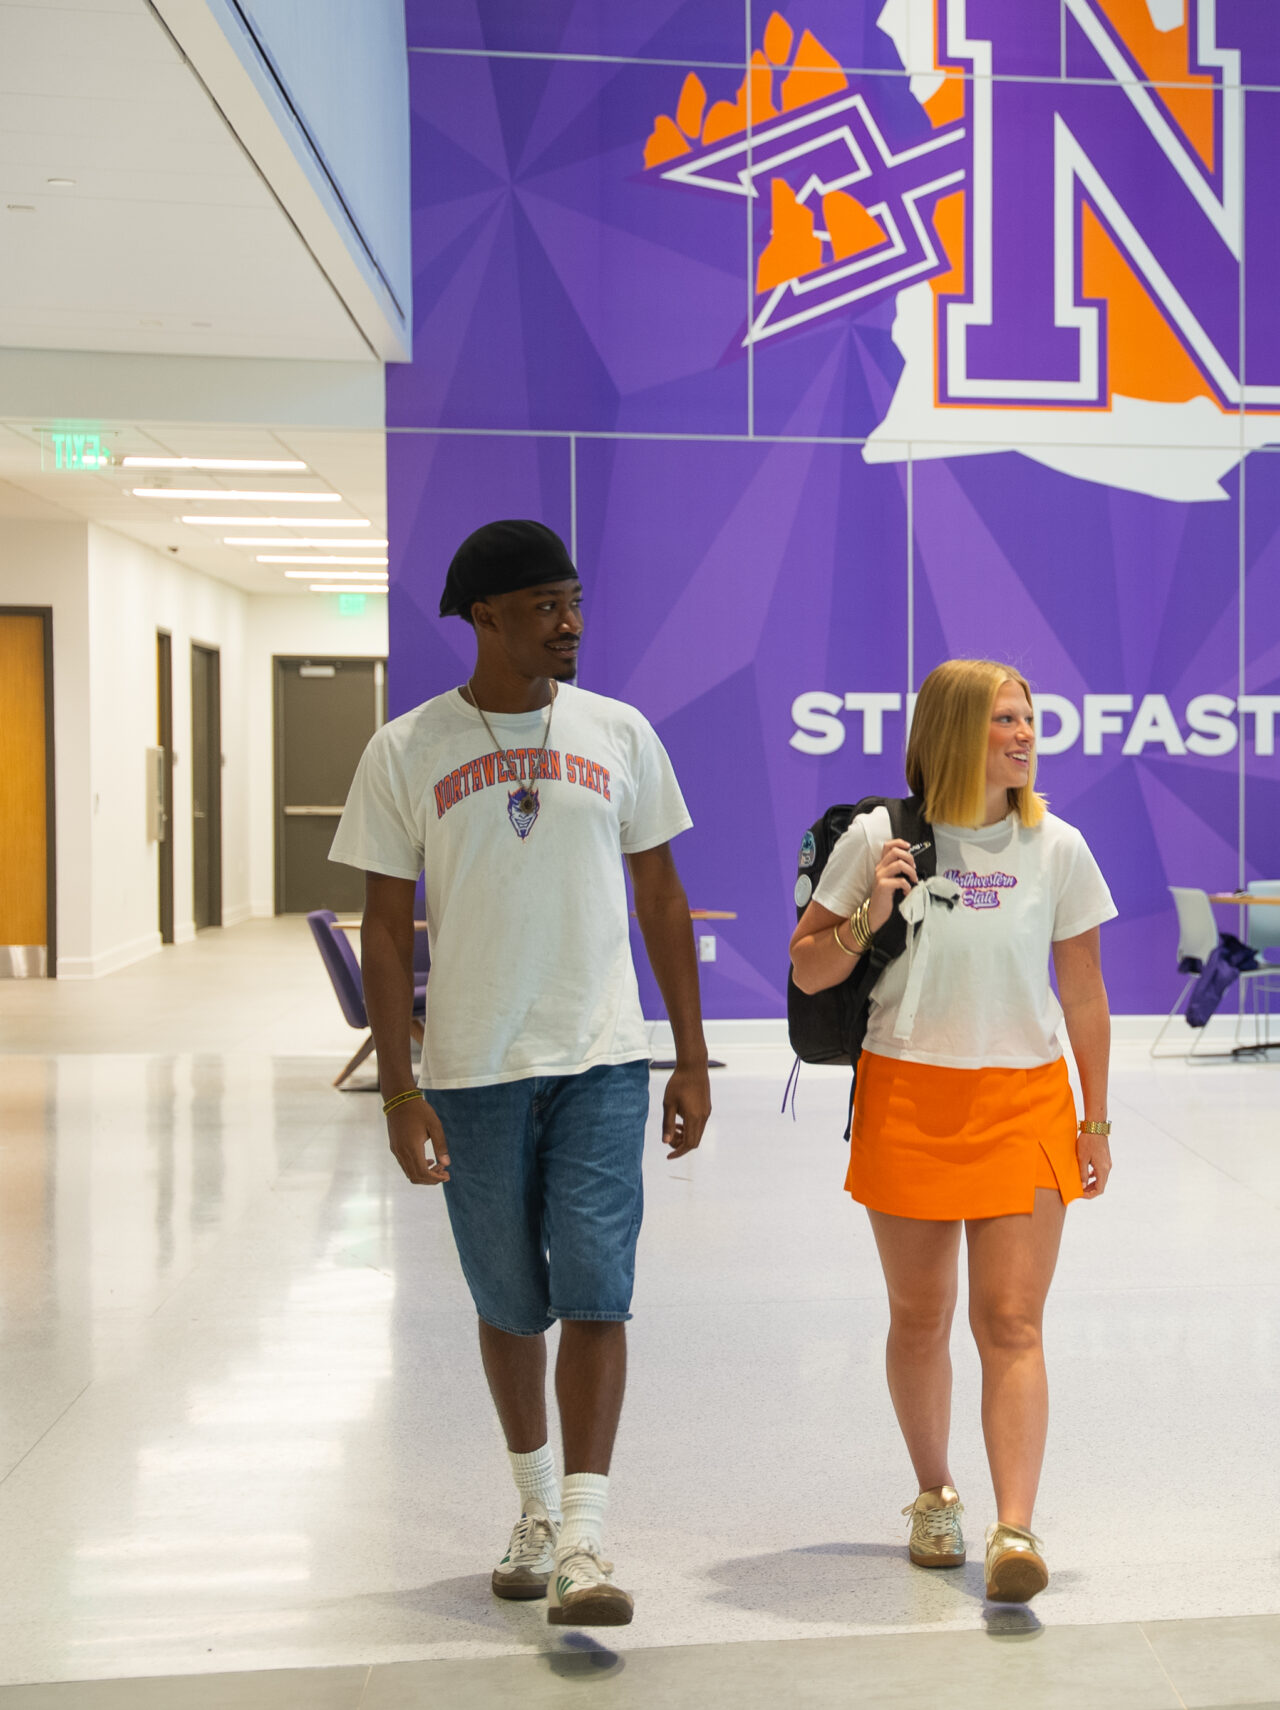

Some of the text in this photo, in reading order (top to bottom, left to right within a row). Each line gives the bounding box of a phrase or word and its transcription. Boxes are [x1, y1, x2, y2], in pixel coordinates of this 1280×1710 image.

[433, 748, 612, 820] NORTHWESTERN STATE
[962, 887, 1000, 910] State
